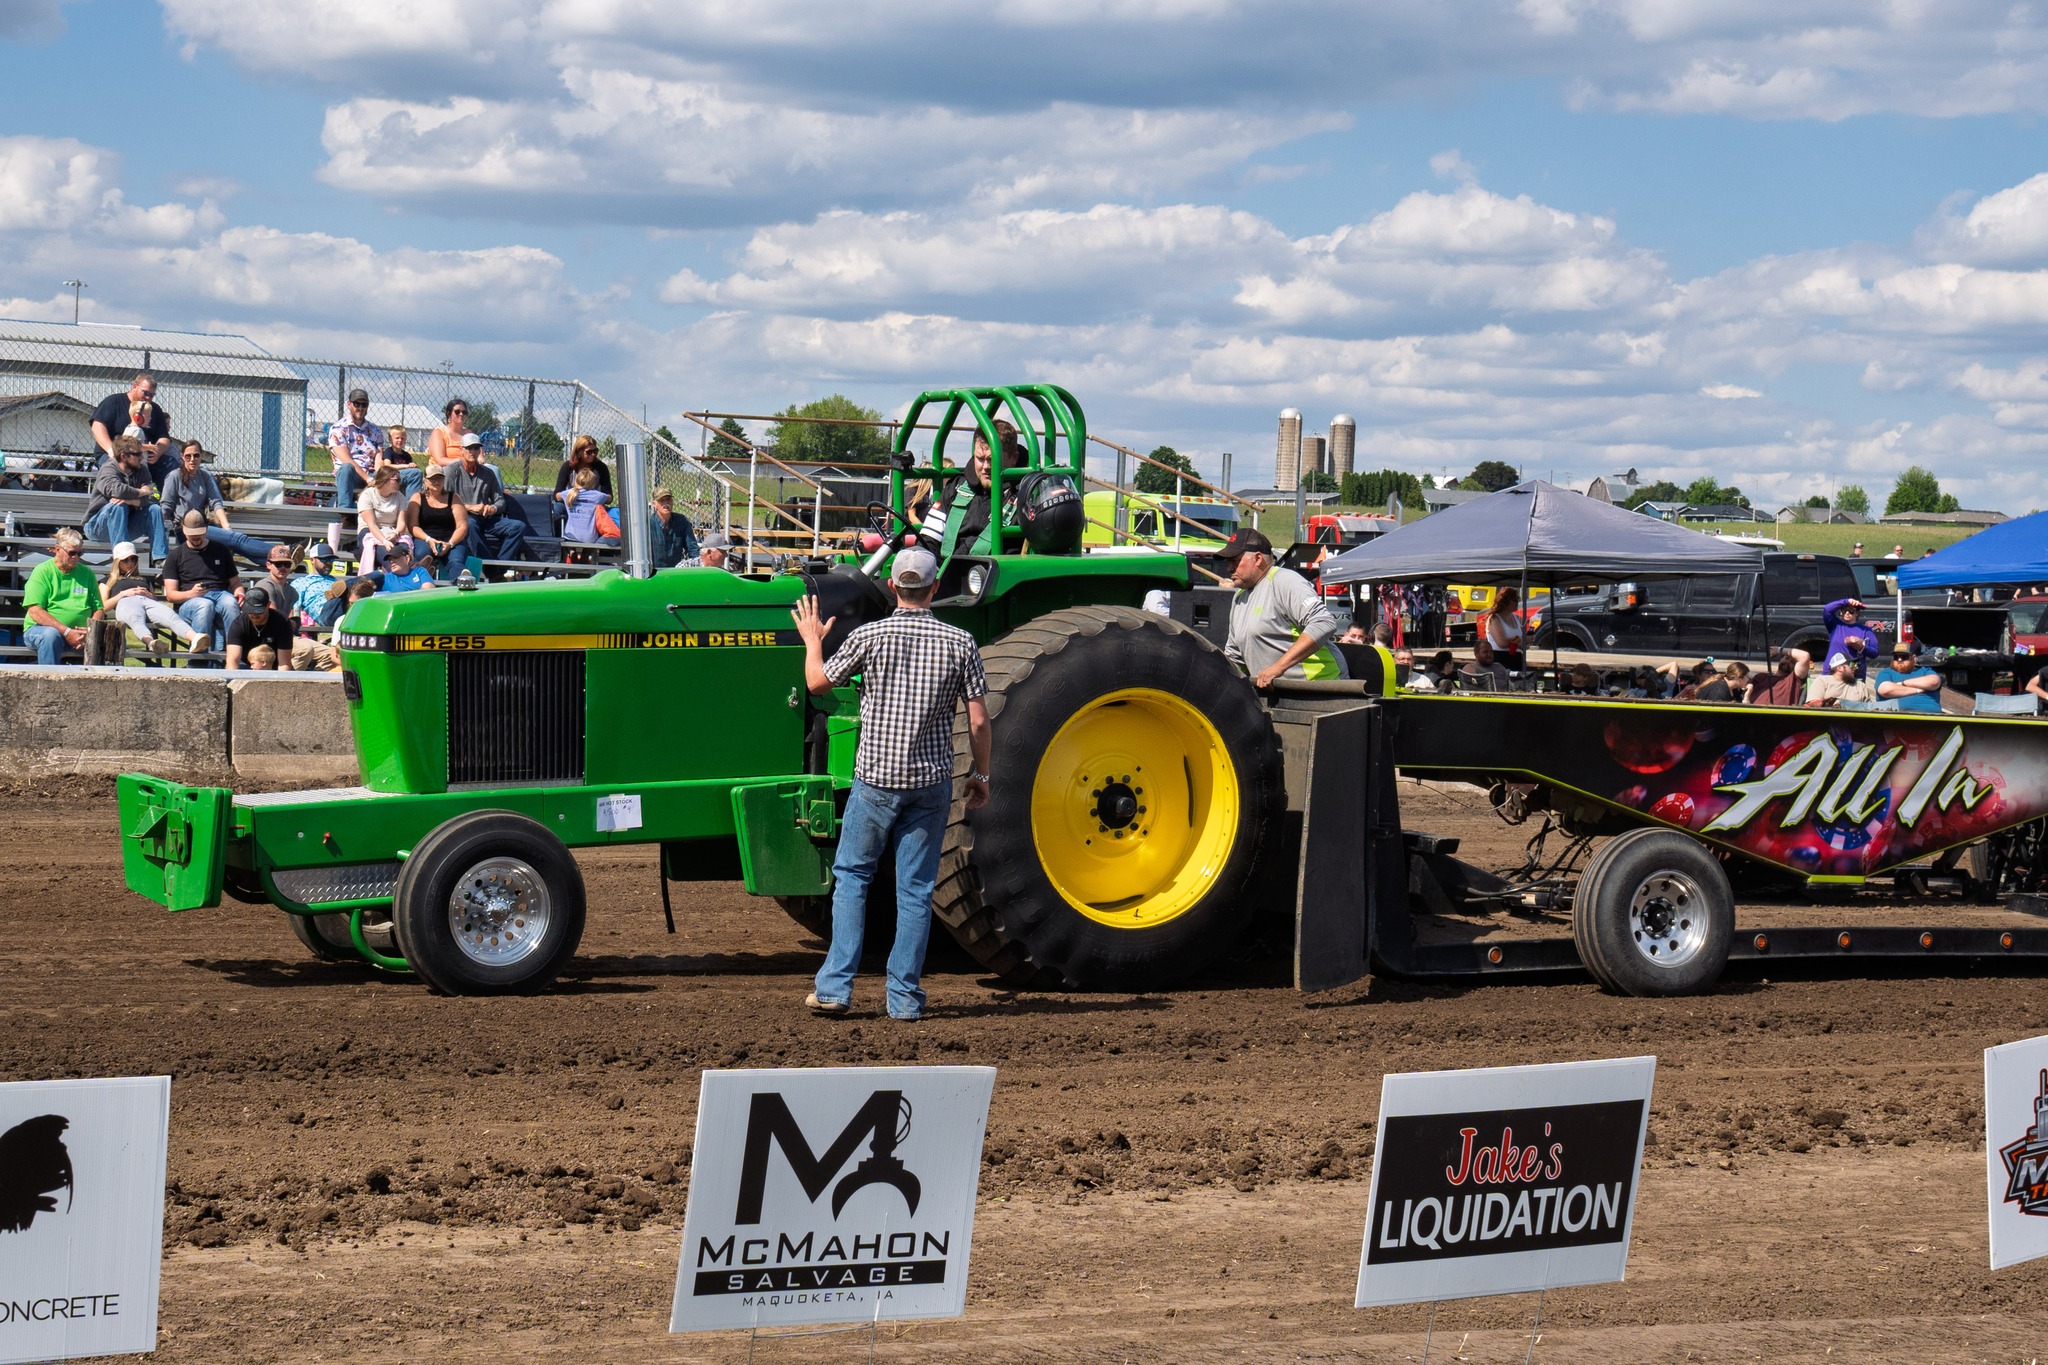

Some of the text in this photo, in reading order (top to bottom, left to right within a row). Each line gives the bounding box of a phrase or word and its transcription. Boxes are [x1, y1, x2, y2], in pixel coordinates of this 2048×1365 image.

[420, 636, 486, 650] 4255
[642, 632, 777, 648] JOHN DEERE
[1699, 725, 1992, 832] All In
[1446, 1122, 1563, 1186] Jake's
[1379, 1181, 1623, 1250] LIQUIDATION
[727, 1266, 914, 1291] SALVAGE
[742, 1290, 894, 1307] MAQUOKETA, IA
